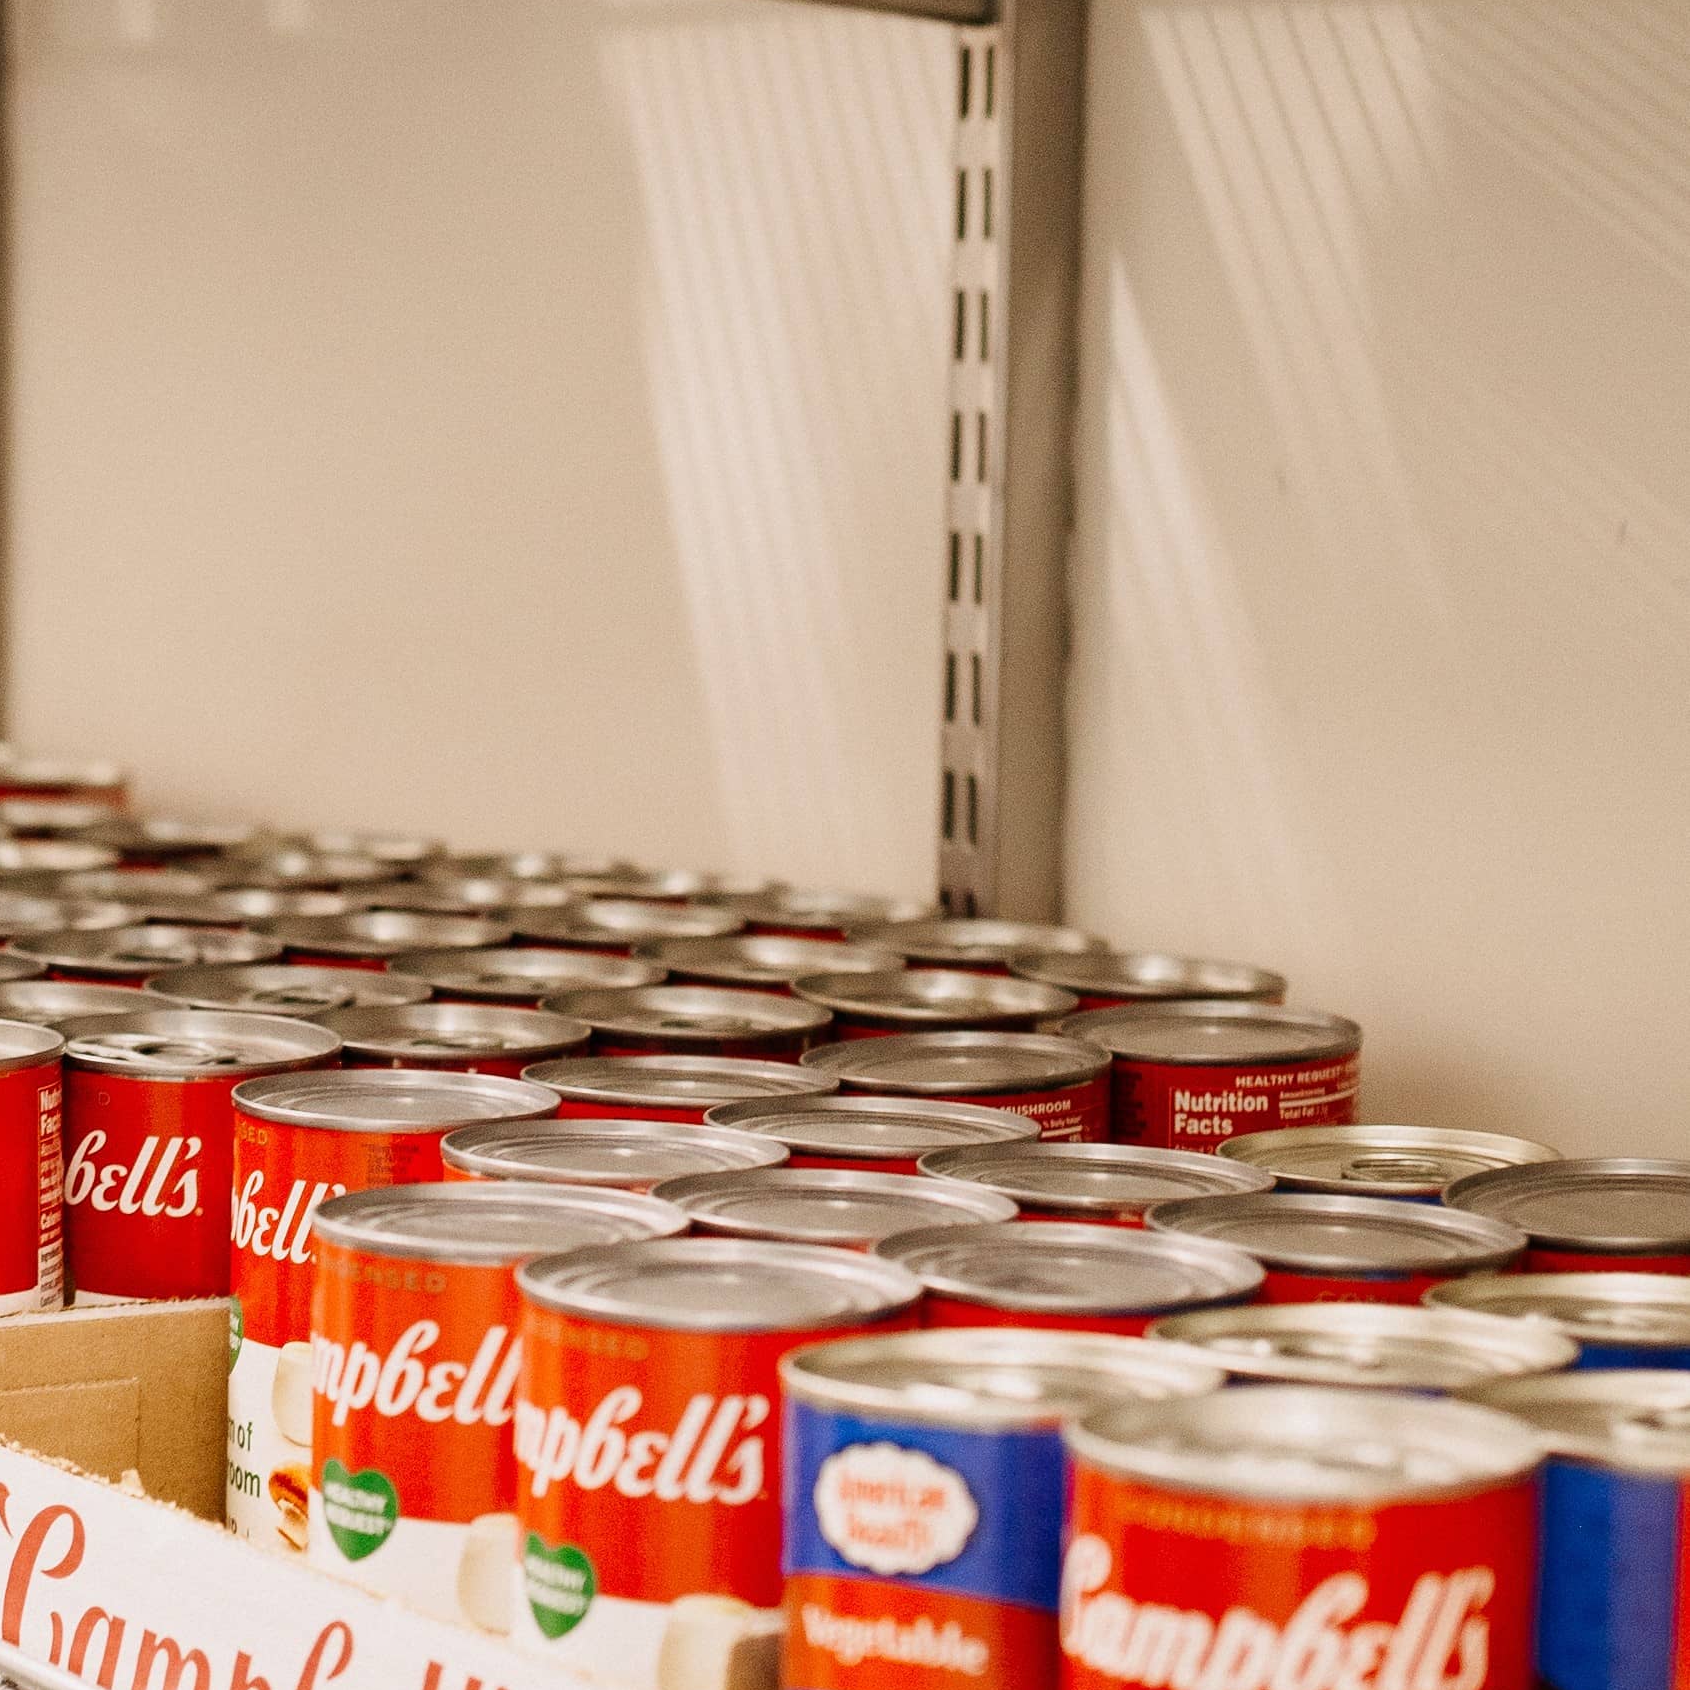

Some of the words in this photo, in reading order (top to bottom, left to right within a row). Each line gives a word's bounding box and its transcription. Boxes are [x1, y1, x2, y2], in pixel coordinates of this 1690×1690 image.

[1234, 1072, 1295, 1090] HEALTHY
[1173, 1089, 1270, 1113] Nutrition
[1173, 1112, 1235, 1137] Facts
